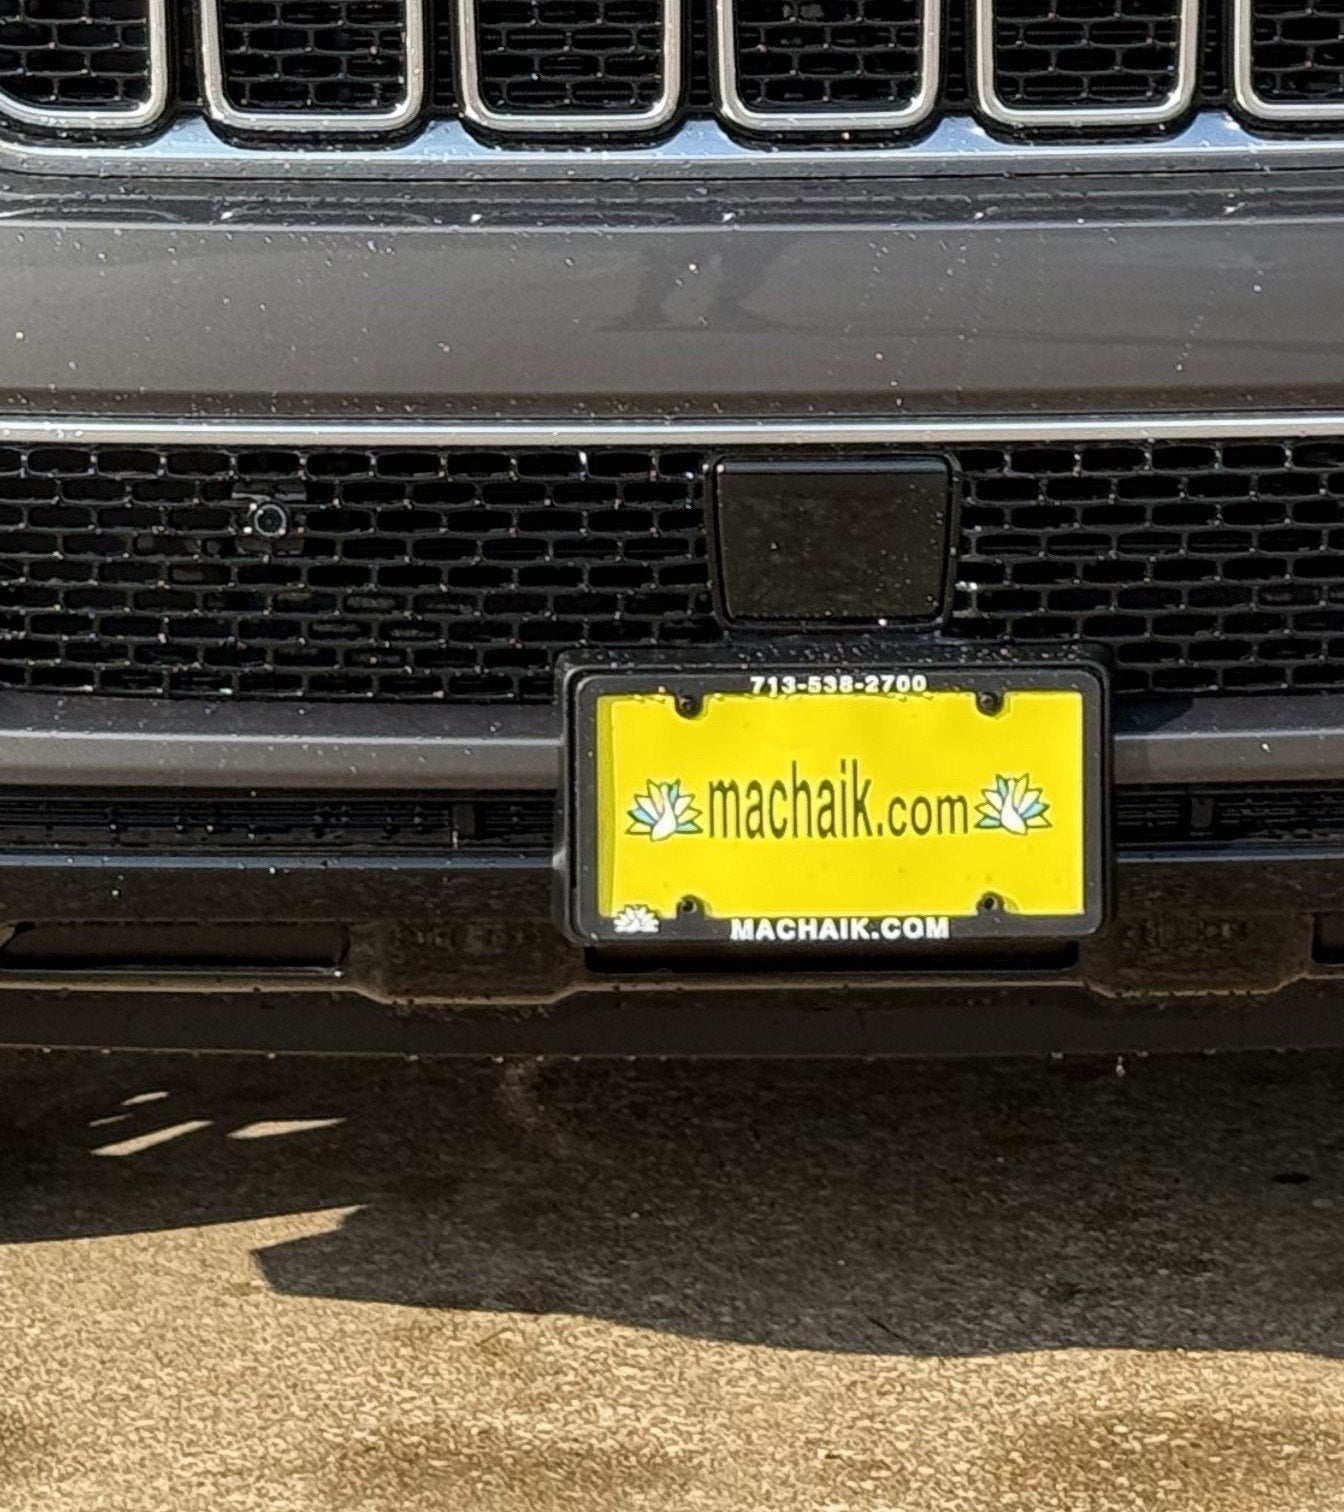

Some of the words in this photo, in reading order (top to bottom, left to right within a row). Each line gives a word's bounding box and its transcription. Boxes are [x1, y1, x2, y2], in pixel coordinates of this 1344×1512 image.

[749, 675, 928, 694] 713-538-2700
[708, 759, 969, 839] machaik.com
[729, 917, 950, 941] MACHAIK.COM
